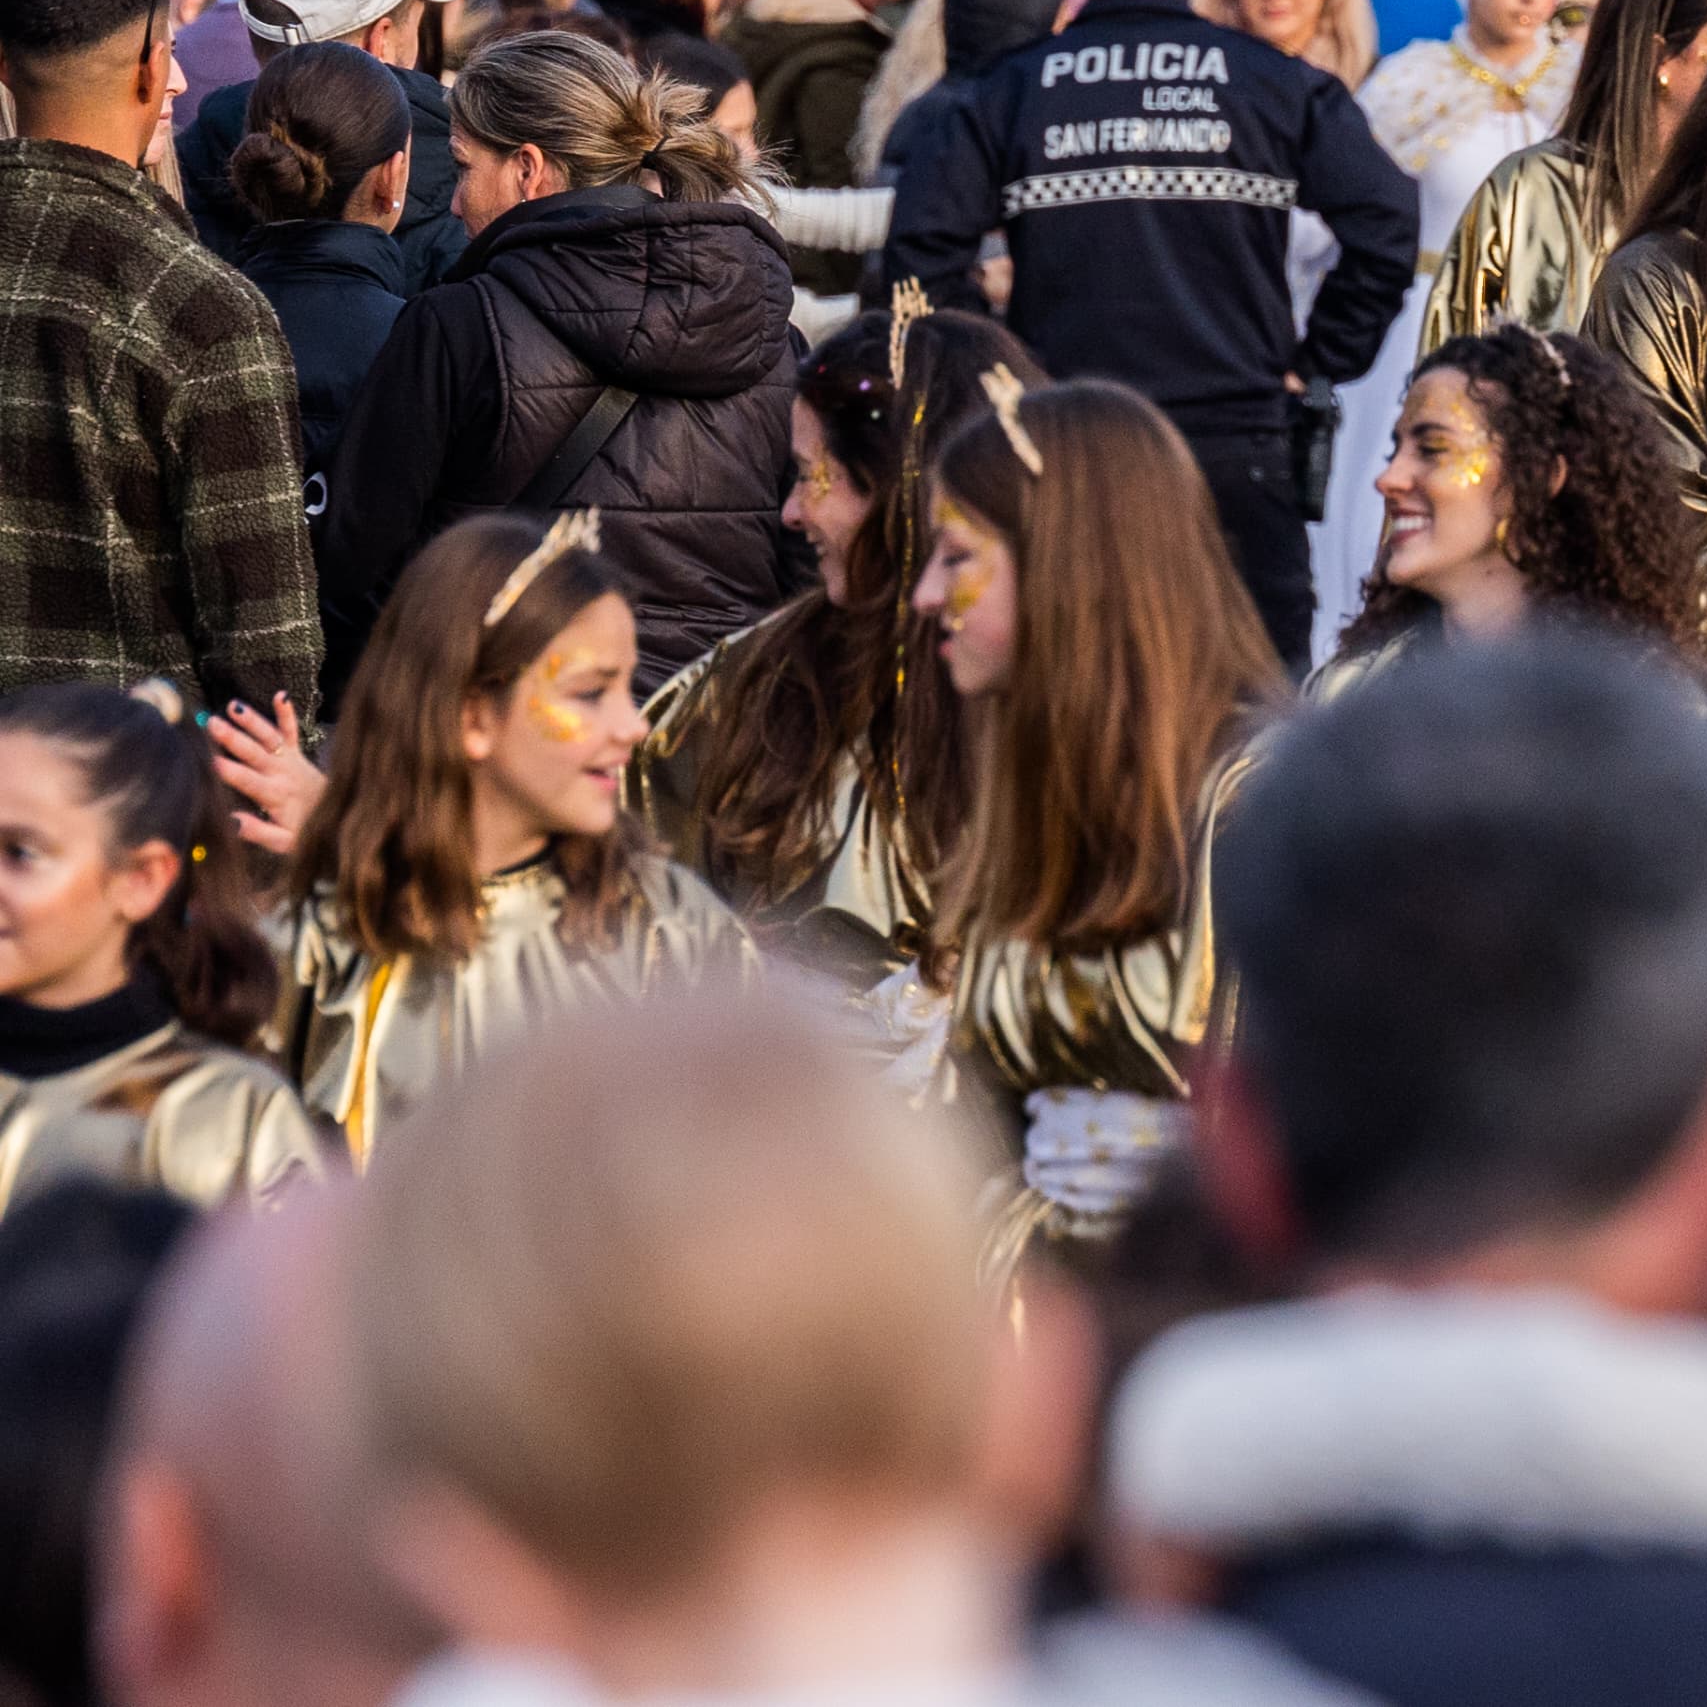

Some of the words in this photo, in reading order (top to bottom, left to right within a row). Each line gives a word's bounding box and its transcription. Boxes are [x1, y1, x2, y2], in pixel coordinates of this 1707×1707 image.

[1041, 41, 1230, 88] POLICIA
[1142, 86, 1221, 112] LOCAL
[1044, 120, 1097, 160] SAN
[1098, 117, 1232, 154] FERNANDO
